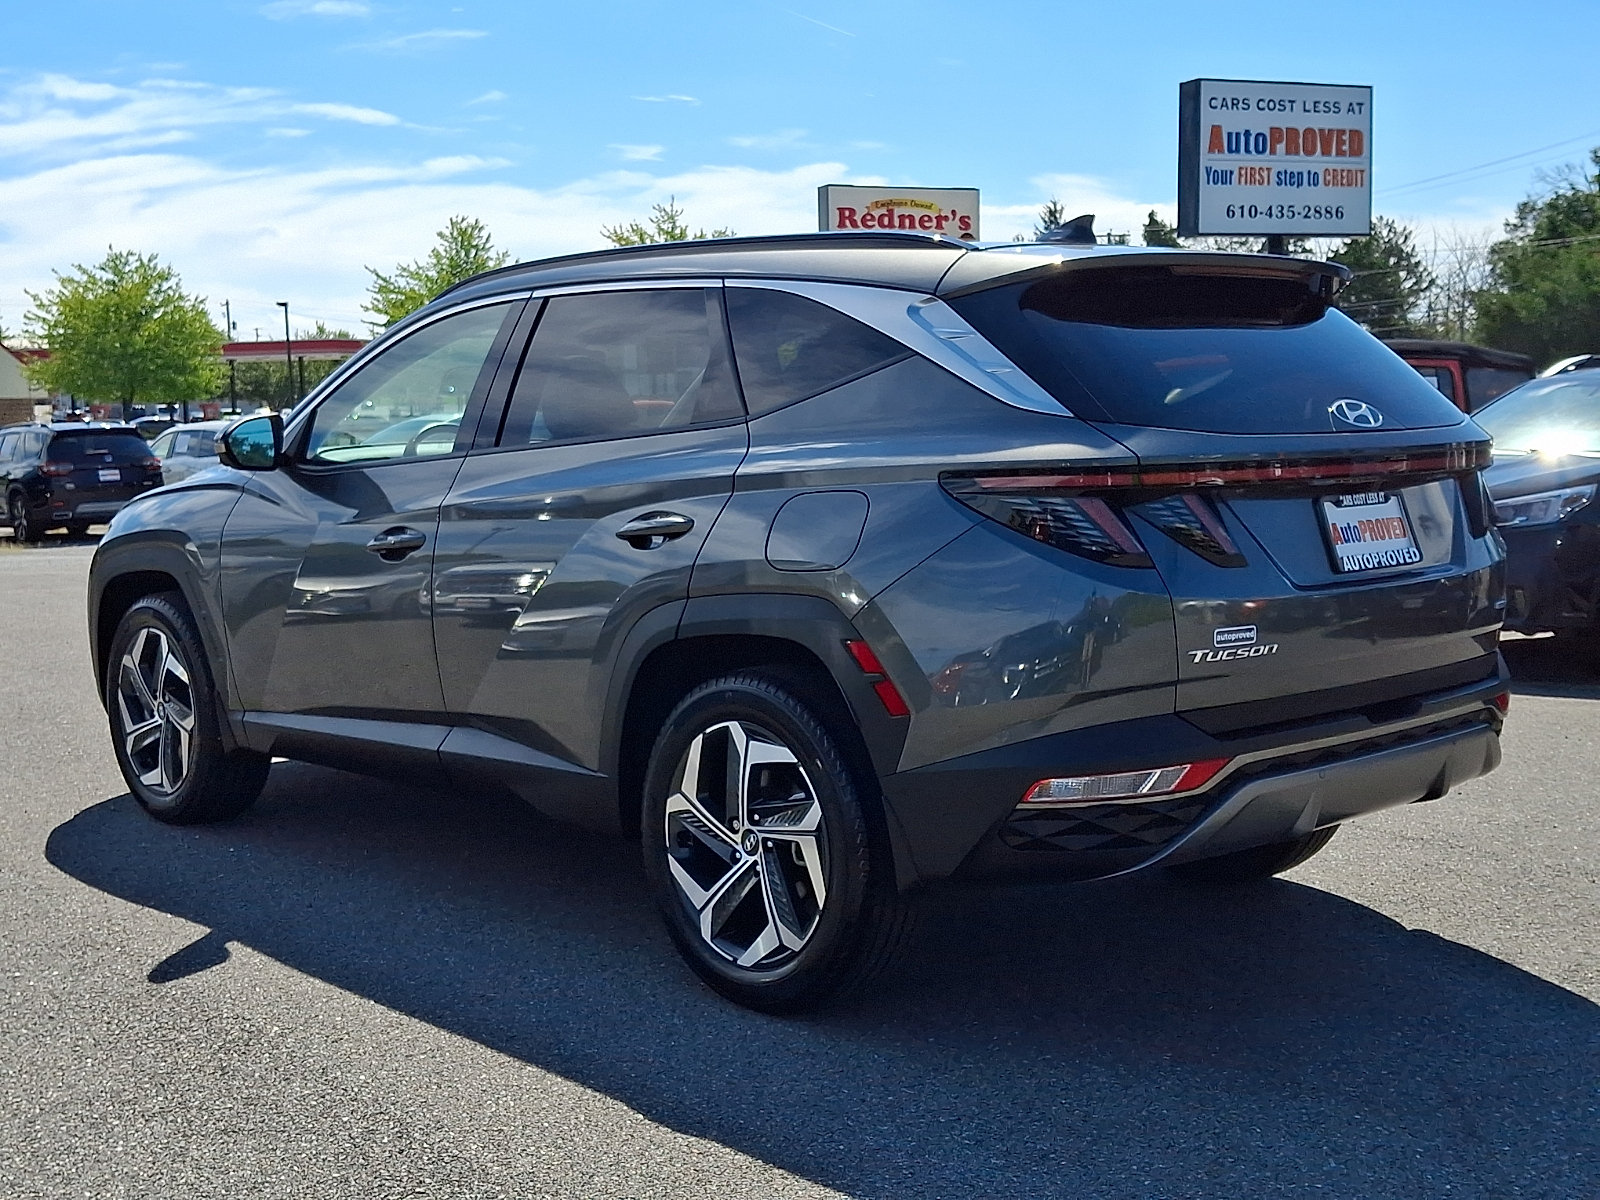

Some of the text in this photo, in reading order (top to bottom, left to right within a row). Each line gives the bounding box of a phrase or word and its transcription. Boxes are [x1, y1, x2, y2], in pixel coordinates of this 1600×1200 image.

[1208, 97, 1364, 115] CARS COST LESS AT
[1207, 124, 1364, 158] AutoPROVED
[1205, 166, 1365, 189] Your FIRST step to CREDIT
[836, 207, 972, 232] Redner's
[1226, 204, 1345, 220] 610-435-2886
[1330, 516, 1408, 546] AutoPROVED
[1343, 547, 1420, 572] AUTOPROVED
[1216, 629, 1255, 642] autoproved
